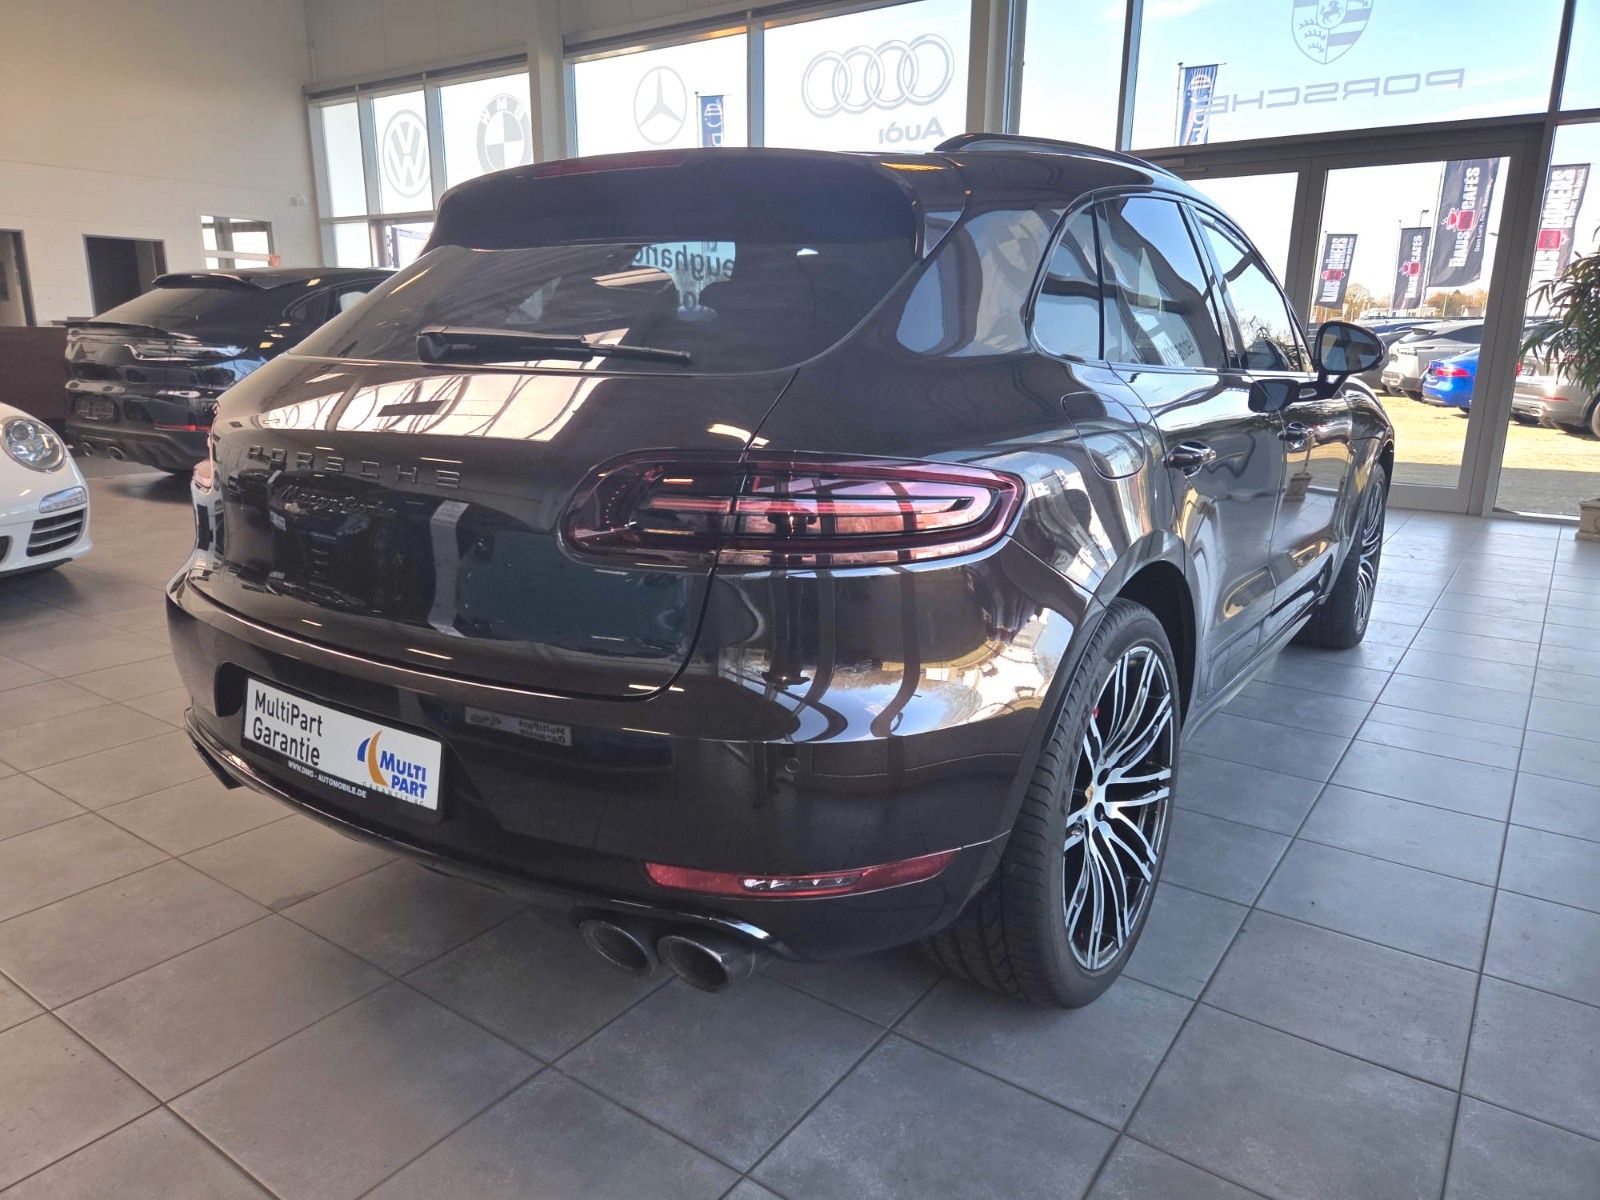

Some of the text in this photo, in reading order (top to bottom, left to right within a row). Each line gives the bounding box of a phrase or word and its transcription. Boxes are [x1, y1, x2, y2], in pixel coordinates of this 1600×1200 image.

[248, 445, 460, 489] PORSCHE
[255, 690, 323, 737] MultiPart
[253, 716, 320, 767] Garantie
[380, 750, 427, 782] MULTI
[318, 774, 367, 799] AUTOMOBILE.DE
[391, 775, 428, 799] PART
